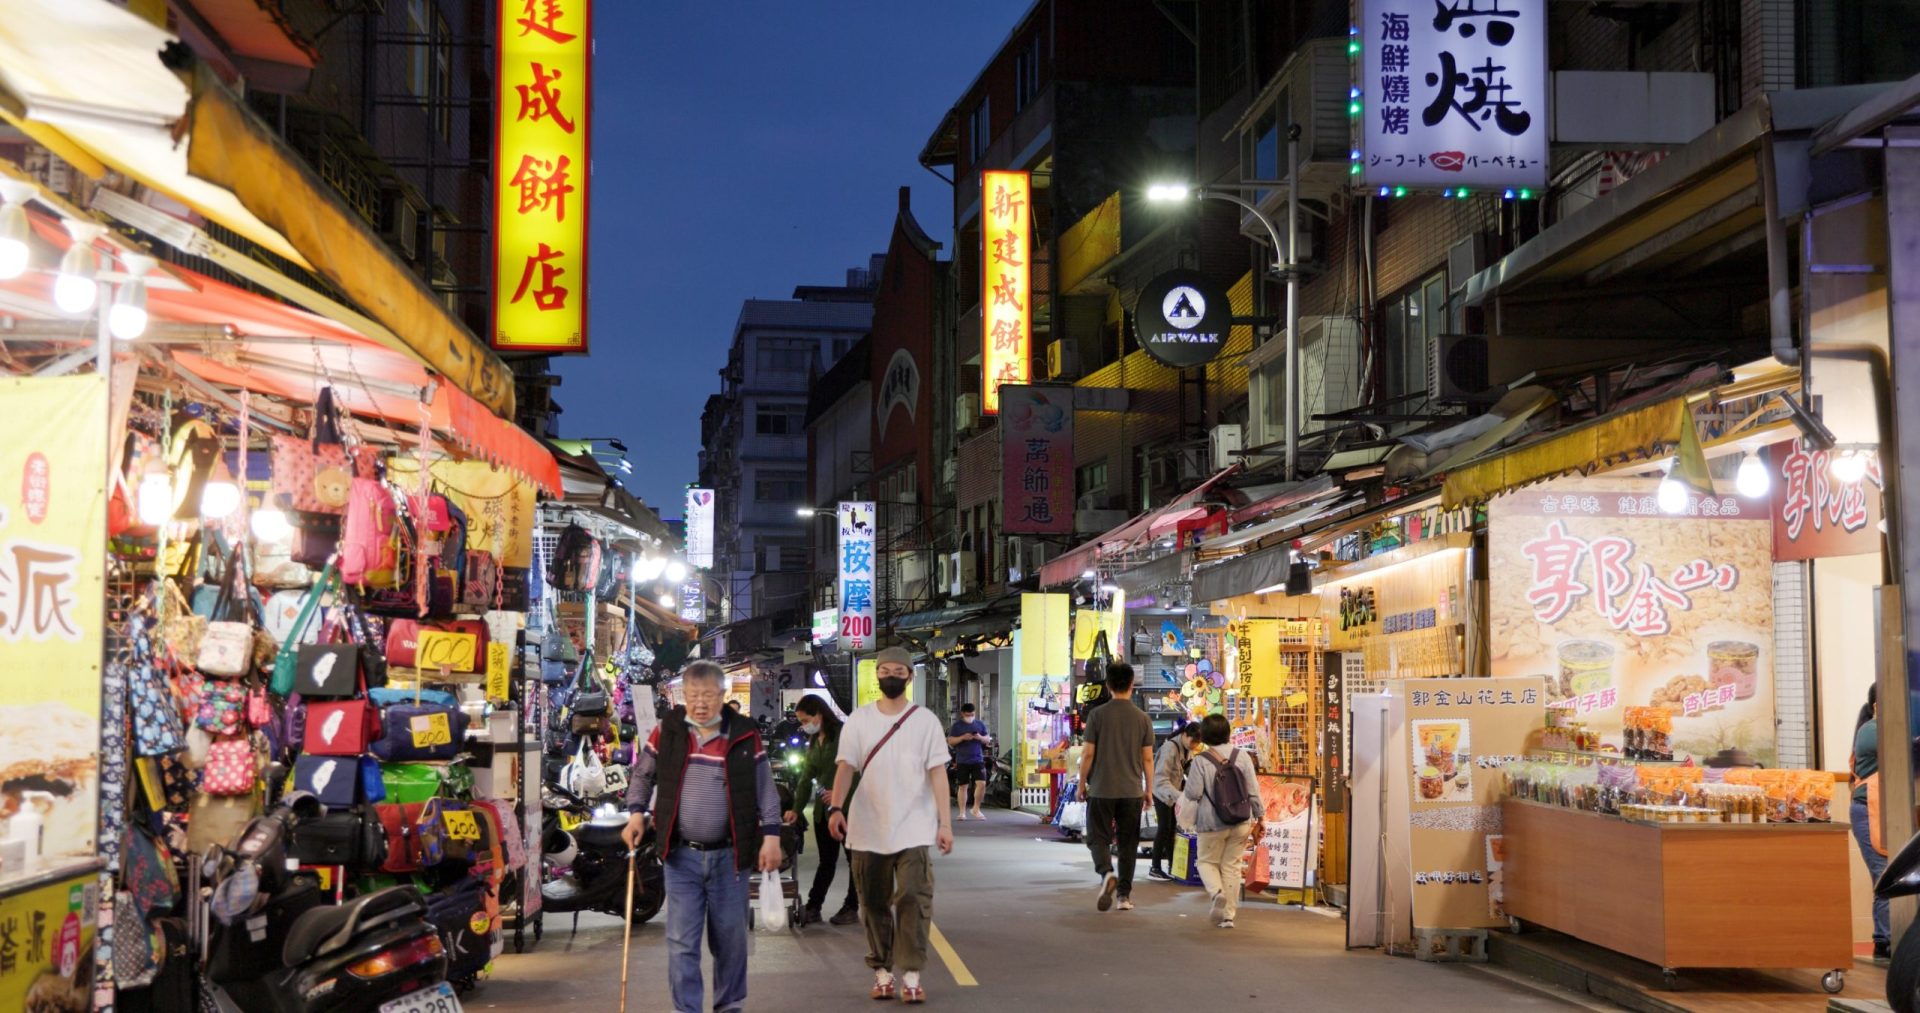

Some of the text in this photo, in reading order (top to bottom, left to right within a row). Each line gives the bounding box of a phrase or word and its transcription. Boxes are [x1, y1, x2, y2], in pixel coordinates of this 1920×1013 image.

[1381, 13, 1409, 135] 海鮮燒烤
[1370, 154, 1539, 169] シーフード バーベキュー
[1150, 332, 1219, 344] AIRWALK
[1019, 438, 1053, 524] 萬飾通
[1540, 495, 1600, 514] 古早味
[842, 540, 871, 613] 按摩
[1522, 518, 1741, 637] 郭金山
[842, 616, 872, 637] 200
[420, 635, 472, 664] 100
[851, 637, 863, 649] 元
[1412, 687, 1538, 708] 郭金山花生店
[1550, 687, 1617, 714] 瓜子酥
[1683, 684, 1735, 713] 杏仁酥
[418, 730, 445, 745] 200
[449, 818, 476, 836] 200
